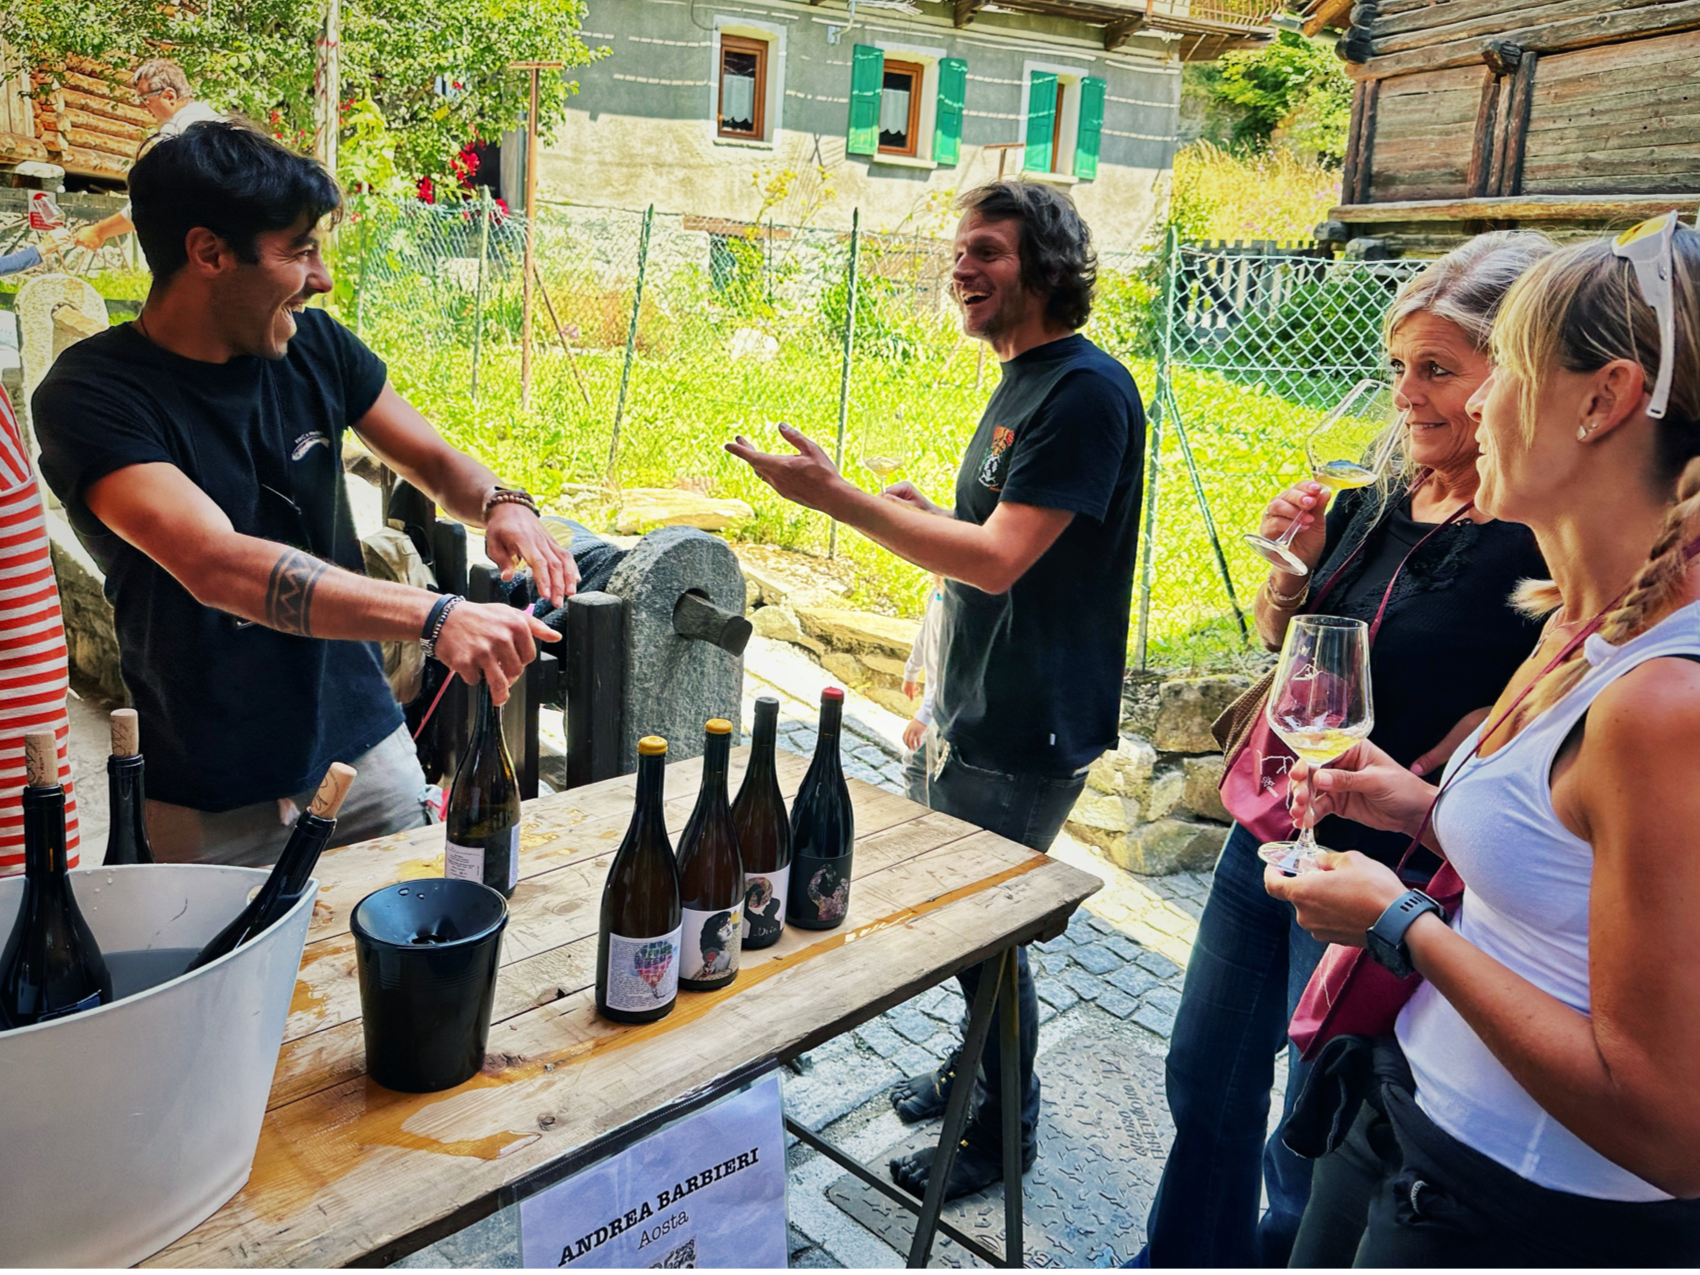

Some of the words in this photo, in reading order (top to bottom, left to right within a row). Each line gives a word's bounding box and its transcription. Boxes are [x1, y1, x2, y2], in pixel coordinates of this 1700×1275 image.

[558, 1201, 654, 1268] ANDREA
[656, 1147, 760, 1212] BARBIERI
[637, 1208, 690, 1250] Aosta
